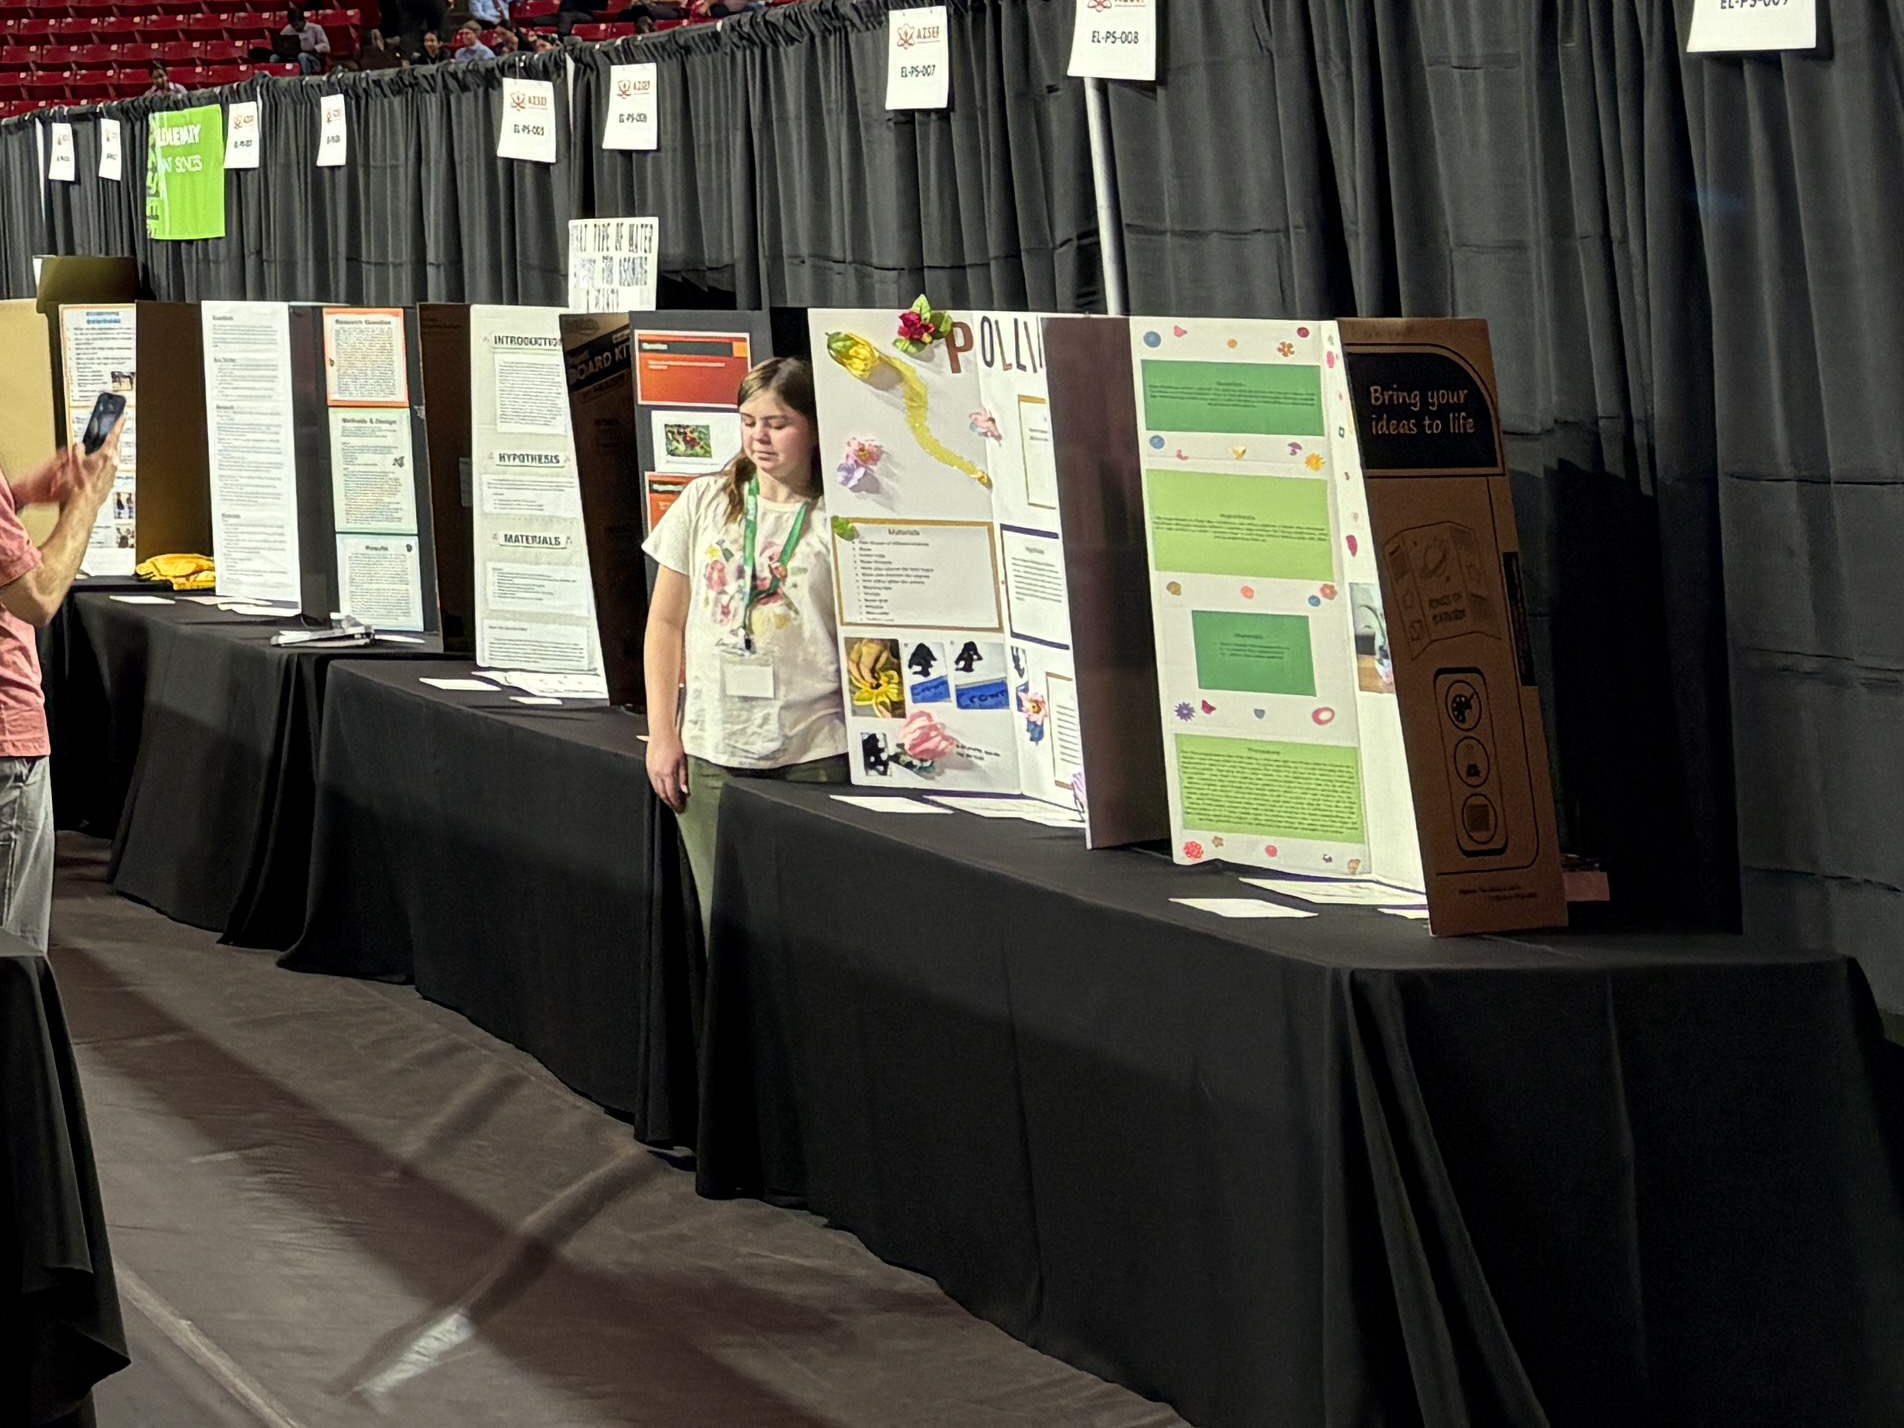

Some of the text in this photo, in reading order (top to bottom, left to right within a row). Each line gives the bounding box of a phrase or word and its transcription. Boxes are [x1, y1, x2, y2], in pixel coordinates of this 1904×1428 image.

[916, 26, 940, 40] AZSEF
[1092, 30, 1139, 45] EL-PS-008
[1370, 384, 1469, 419] Bring your
[1371, 412, 1475, 436] ideas to life
[499, 452, 560, 464] HYPOTHESIS
